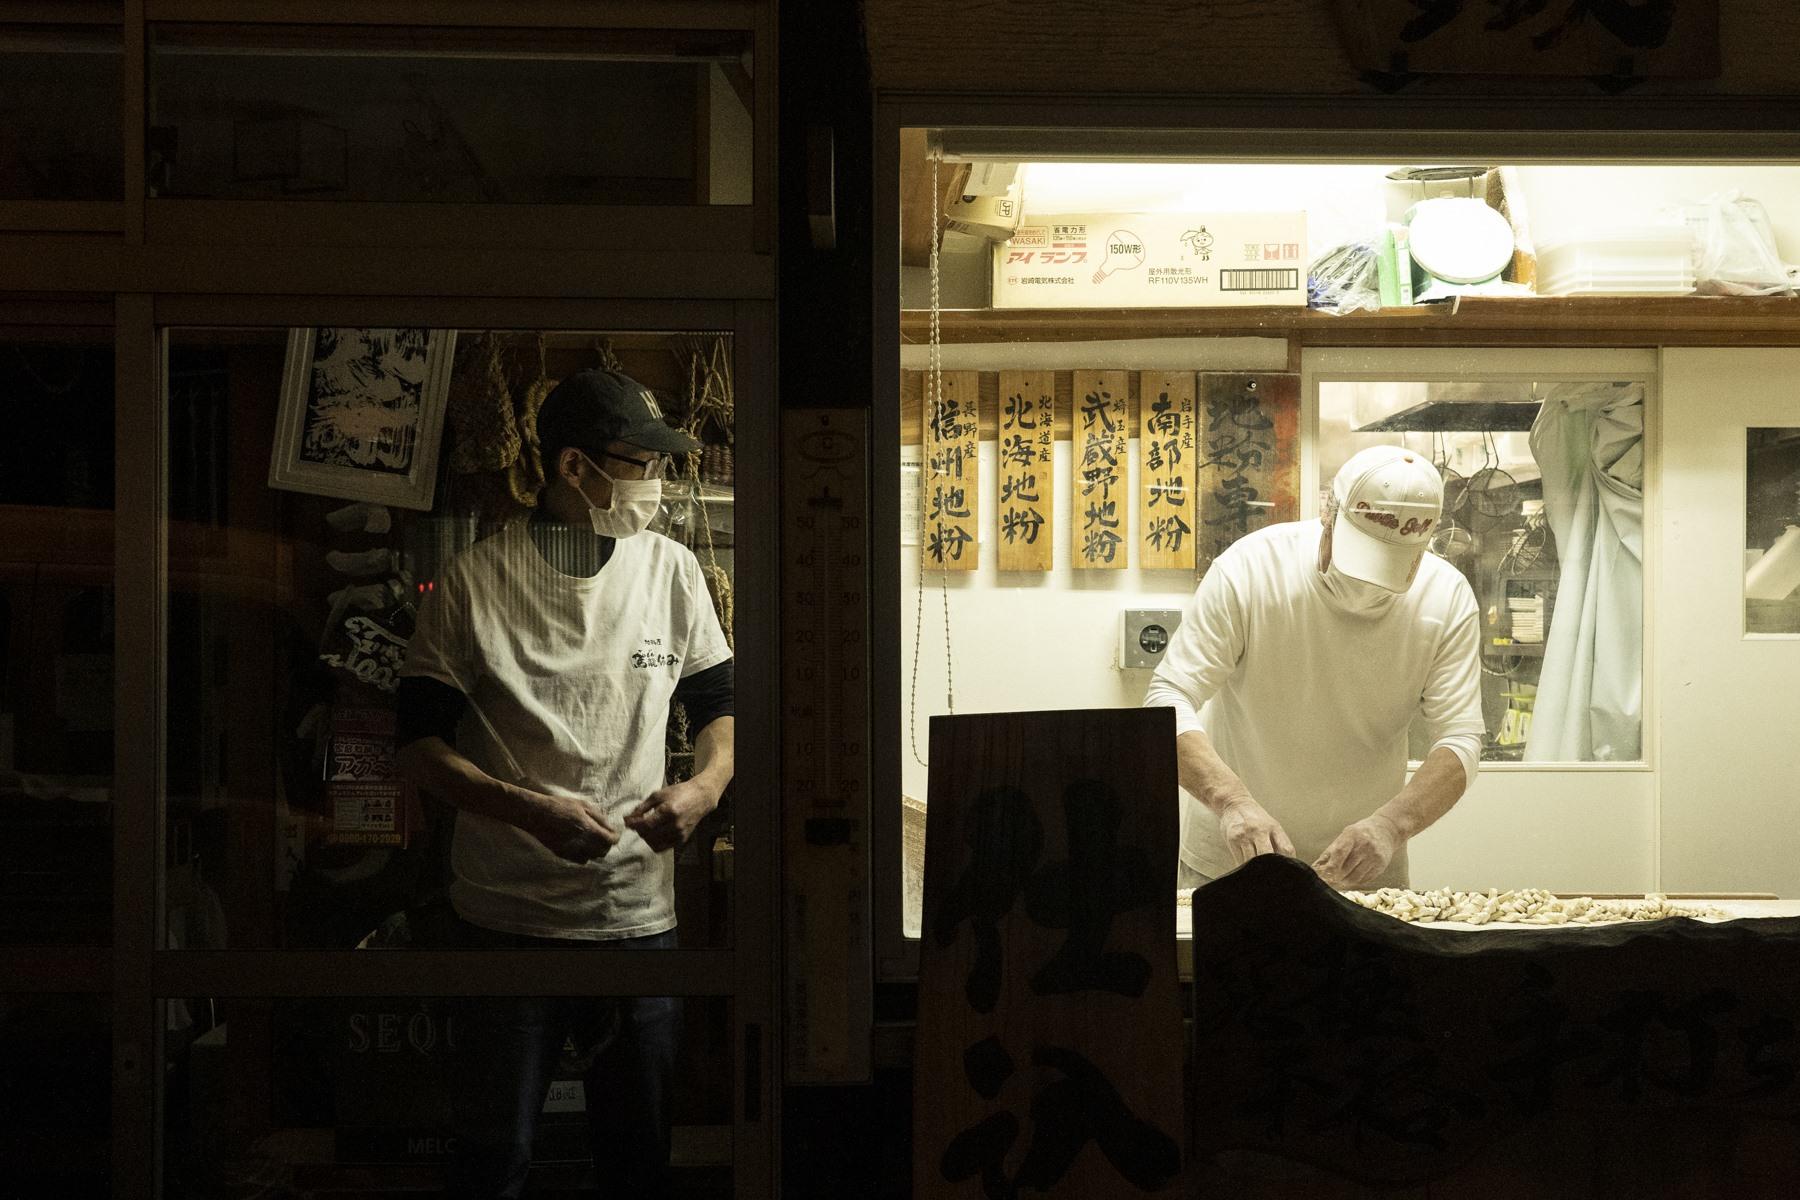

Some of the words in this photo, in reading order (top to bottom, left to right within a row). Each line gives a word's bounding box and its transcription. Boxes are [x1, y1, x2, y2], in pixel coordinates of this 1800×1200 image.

[1006, 251, 1035, 265] アイ
[1110, 244, 1142, 254] 150W形
[1148, 276, 1208, 285] RF110V135WH
[962, 401, 978, 460] 長野産
[1038, 394, 1054, 463] 北海道産
[1179, 398, 1194, 449] 岩手産
[927, 399, 973, 564] 信州地粉
[1001, 393, 1045, 545] 北海地粉
[1079, 391, 1123, 564] 武蔵野地粉
[1146, 392, 1191, 553] 南部地粉
